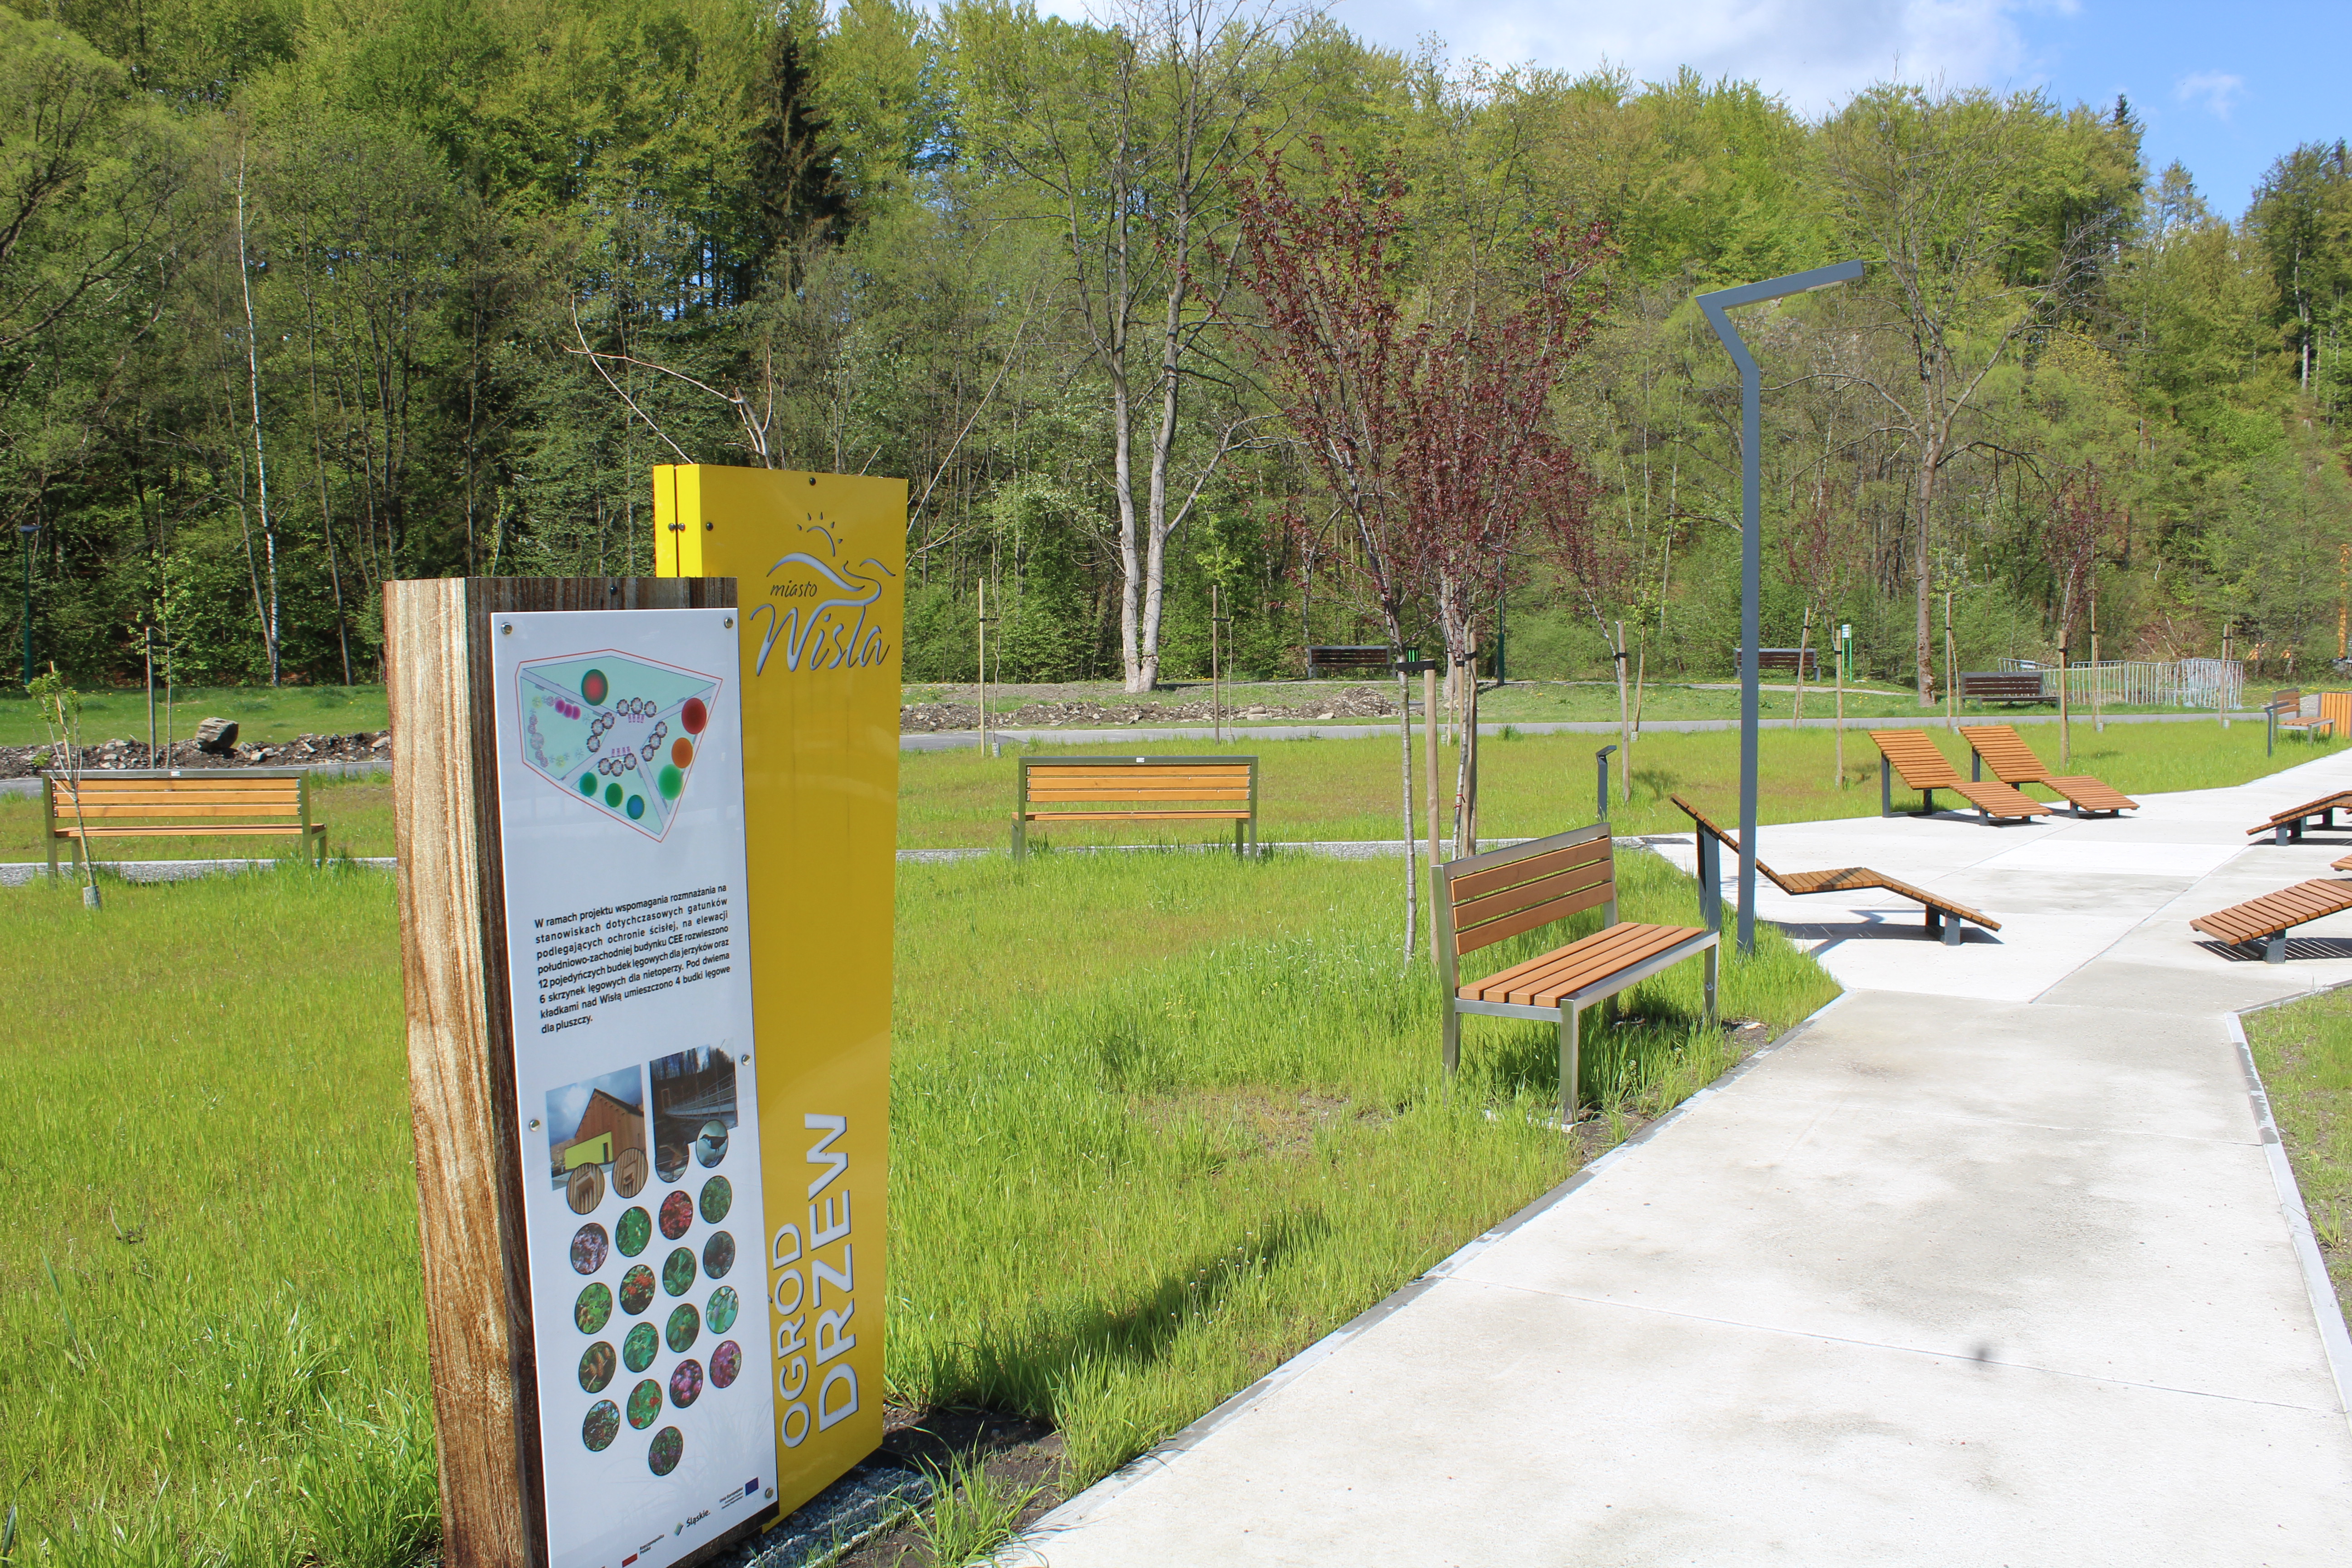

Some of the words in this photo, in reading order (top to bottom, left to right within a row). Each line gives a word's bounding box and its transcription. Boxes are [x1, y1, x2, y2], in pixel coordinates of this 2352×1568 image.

[770, 580, 818, 597] miasto
[534, 918, 544, 928] W
[546, 912, 578, 926] ramach
[580, 907, 613, 921] projektu
[615, 895, 668, 912] wspomagania
[671, 886, 716, 902] rozmnażania
[536, 923, 601, 943] stanowiskach
[606, 906, 683, 929] dotychczasowych
[688, 897, 727, 914] gatunków
[537, 937, 603, 960] podlegających
[608, 929, 645, 943] ochronie
[650, 921, 678, 935] ścisłej,
[696, 910, 728, 924] elewacji
[538, 945, 632, 975] południowo-zachodniej
[634, 939, 666, 952] budynku
[668, 934, 683, 945] CEE
[685, 926, 728, 941] rozwieszono
[539, 979, 549, 989] 12
[550, 966, 606, 988] pojedyńczych
[607, 960, 632, 973] budek
[632, 952, 668, 968] lęgowych
[669, 949, 681, 958] dla
[681, 942, 713, 958] jerzyków
[714, 939, 729, 948] oraz
[539, 994, 545, 1004] 6
[548, 985, 585, 1002] skrzynek
[588, 976, 626, 993] lęgowych
[628, 973, 640, 982] dla
[643, 963, 684, 979] nietoperzy.
[686, 958, 700, 969] Pod
[702, 952, 730, 965] dwiema
[540, 1001, 579, 1019] kładkami
[582, 997, 597, 1008] nad
[599, 992, 622, 1004] Wisłą
[624, 980, 673, 998] umieszczono
[676, 976, 681, 985] 4
[683, 971, 703, 983] budki
[705, 965, 730, 979] lęgowe
[541, 1024, 554, 1033] dla
[556, 1015, 593, 1032] pluszczy.
[804, 1112, 859, 1433] DRZEW
[768, 1222, 810, 1448] OGRÓD
[686, 1509, 710, 1527] Śląskie.
